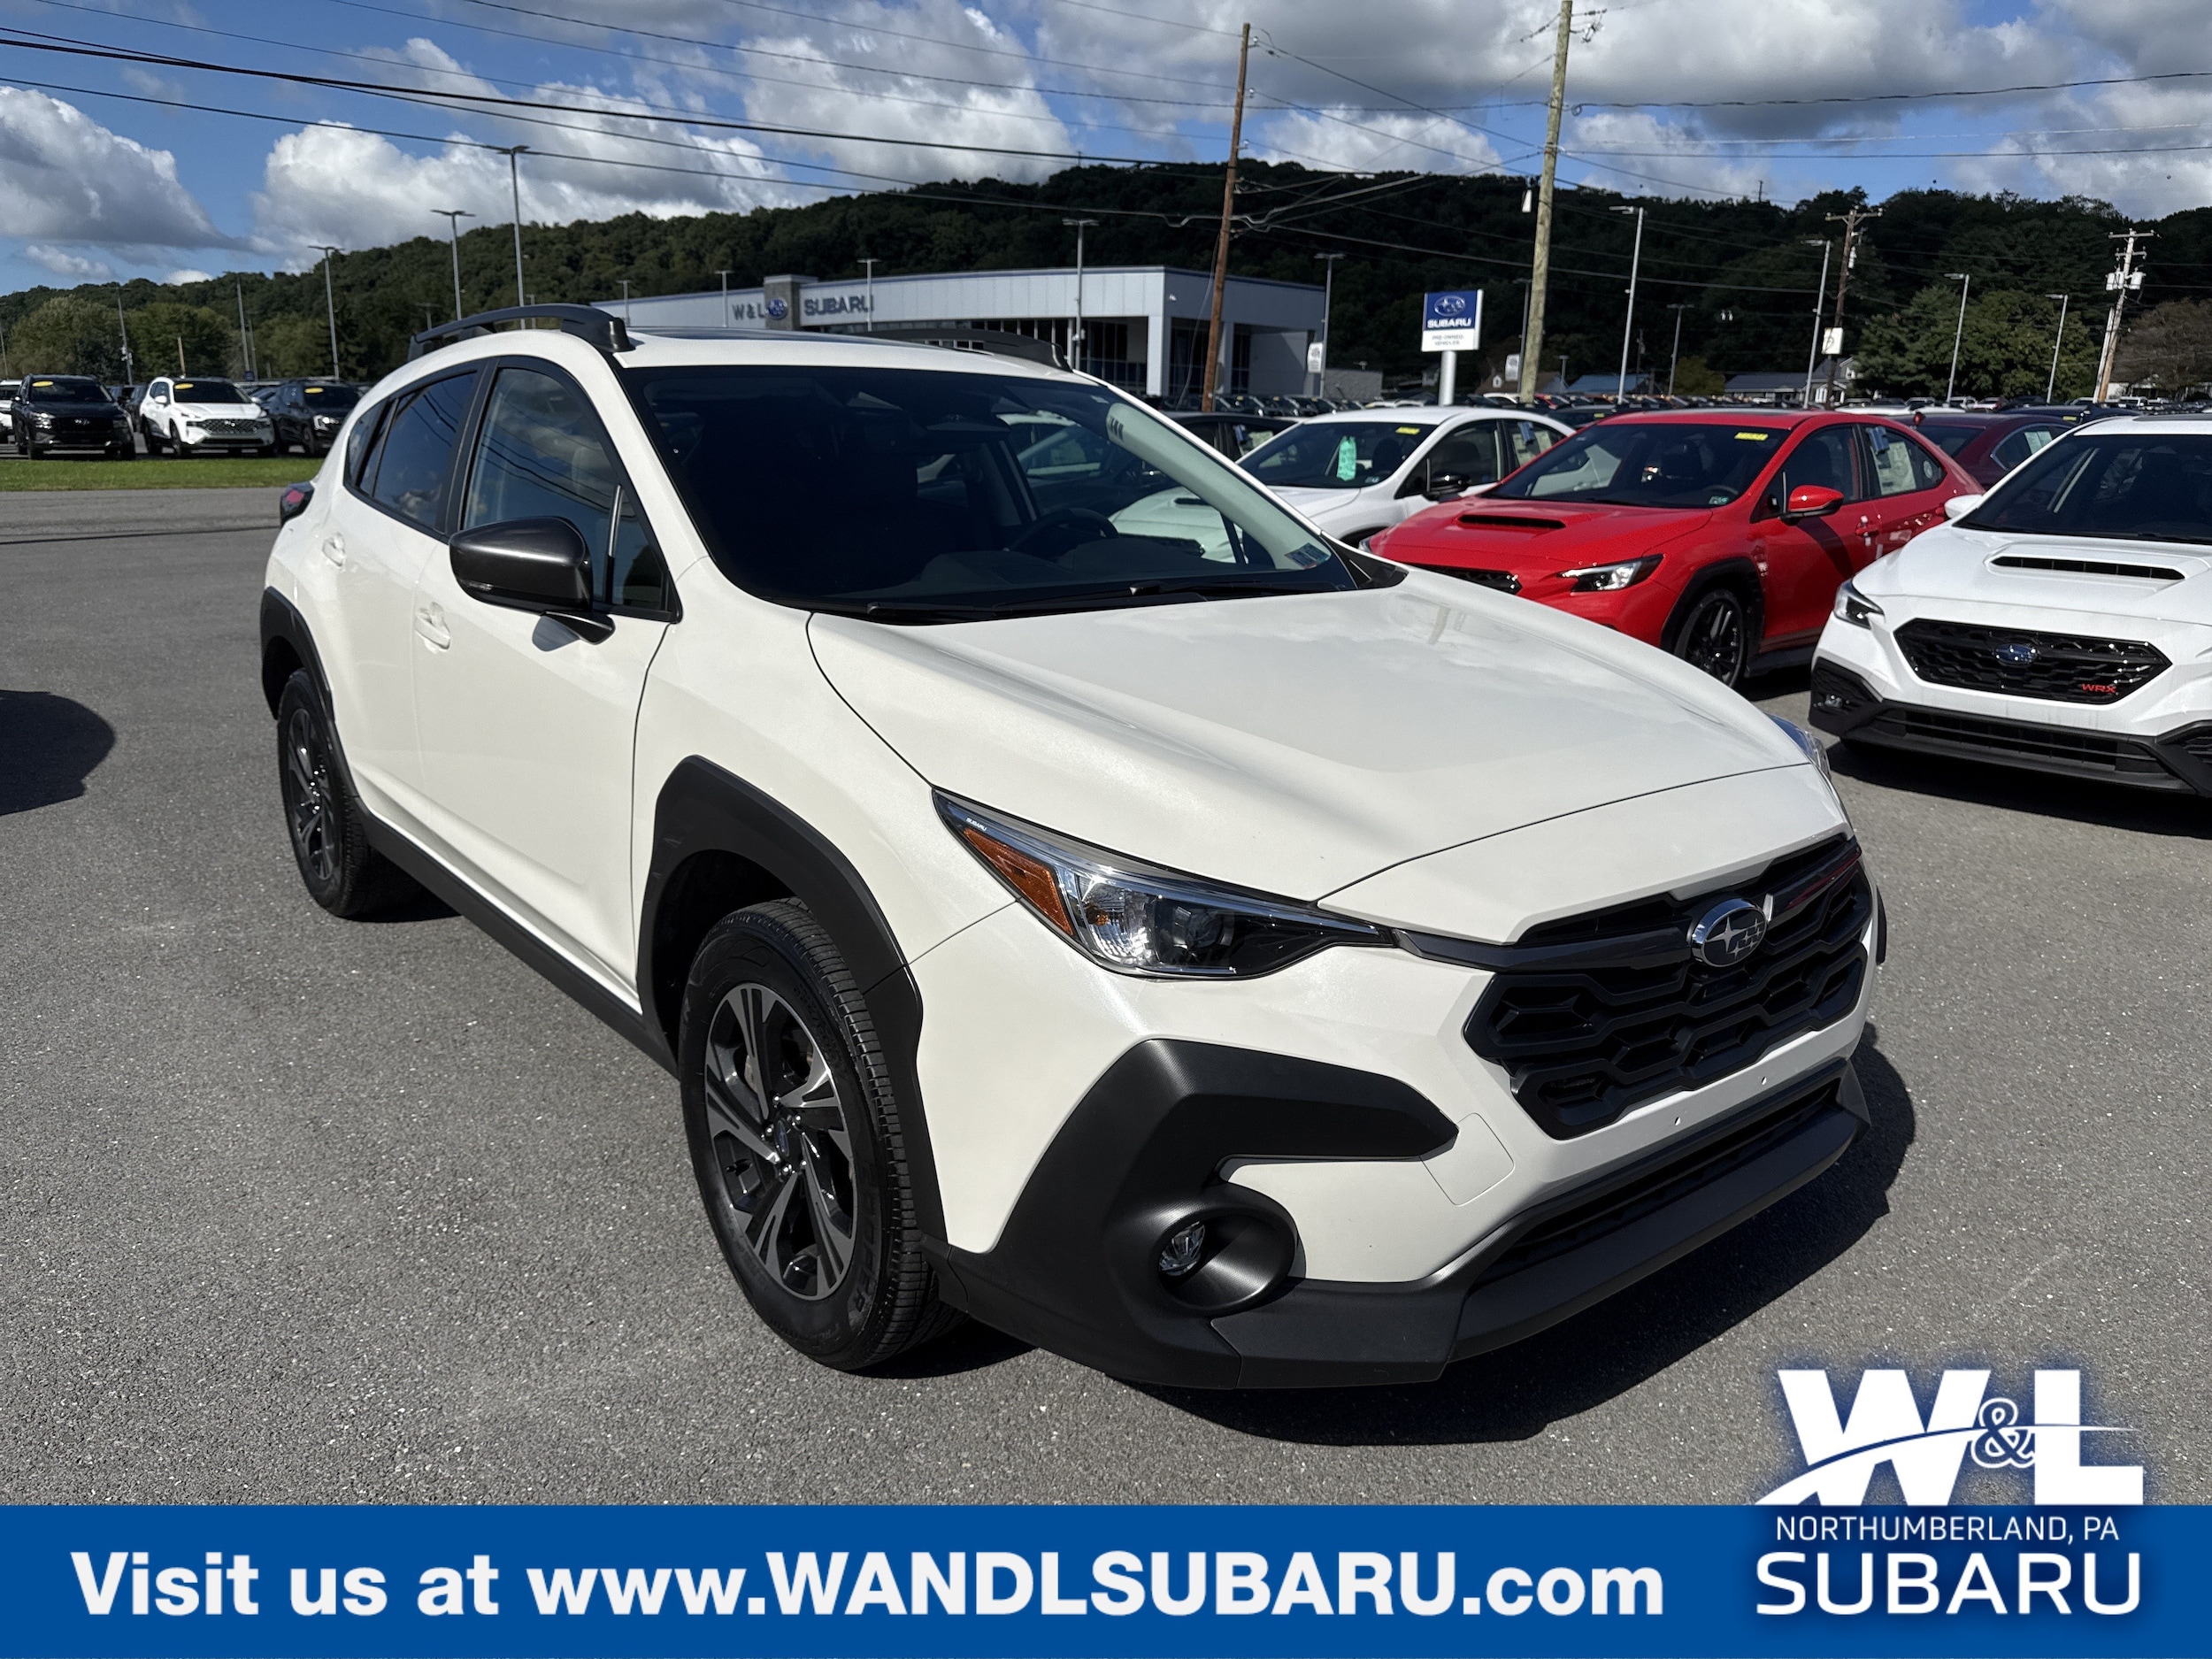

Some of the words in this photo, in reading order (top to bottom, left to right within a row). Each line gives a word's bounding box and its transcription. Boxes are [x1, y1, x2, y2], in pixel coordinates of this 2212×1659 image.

[804, 295, 874, 316] SUBARU
[1427, 318, 1472, 328] SUBARU
[2082, 684, 2116, 693] WRX
[966, 817, 987, 832] SUBARU
